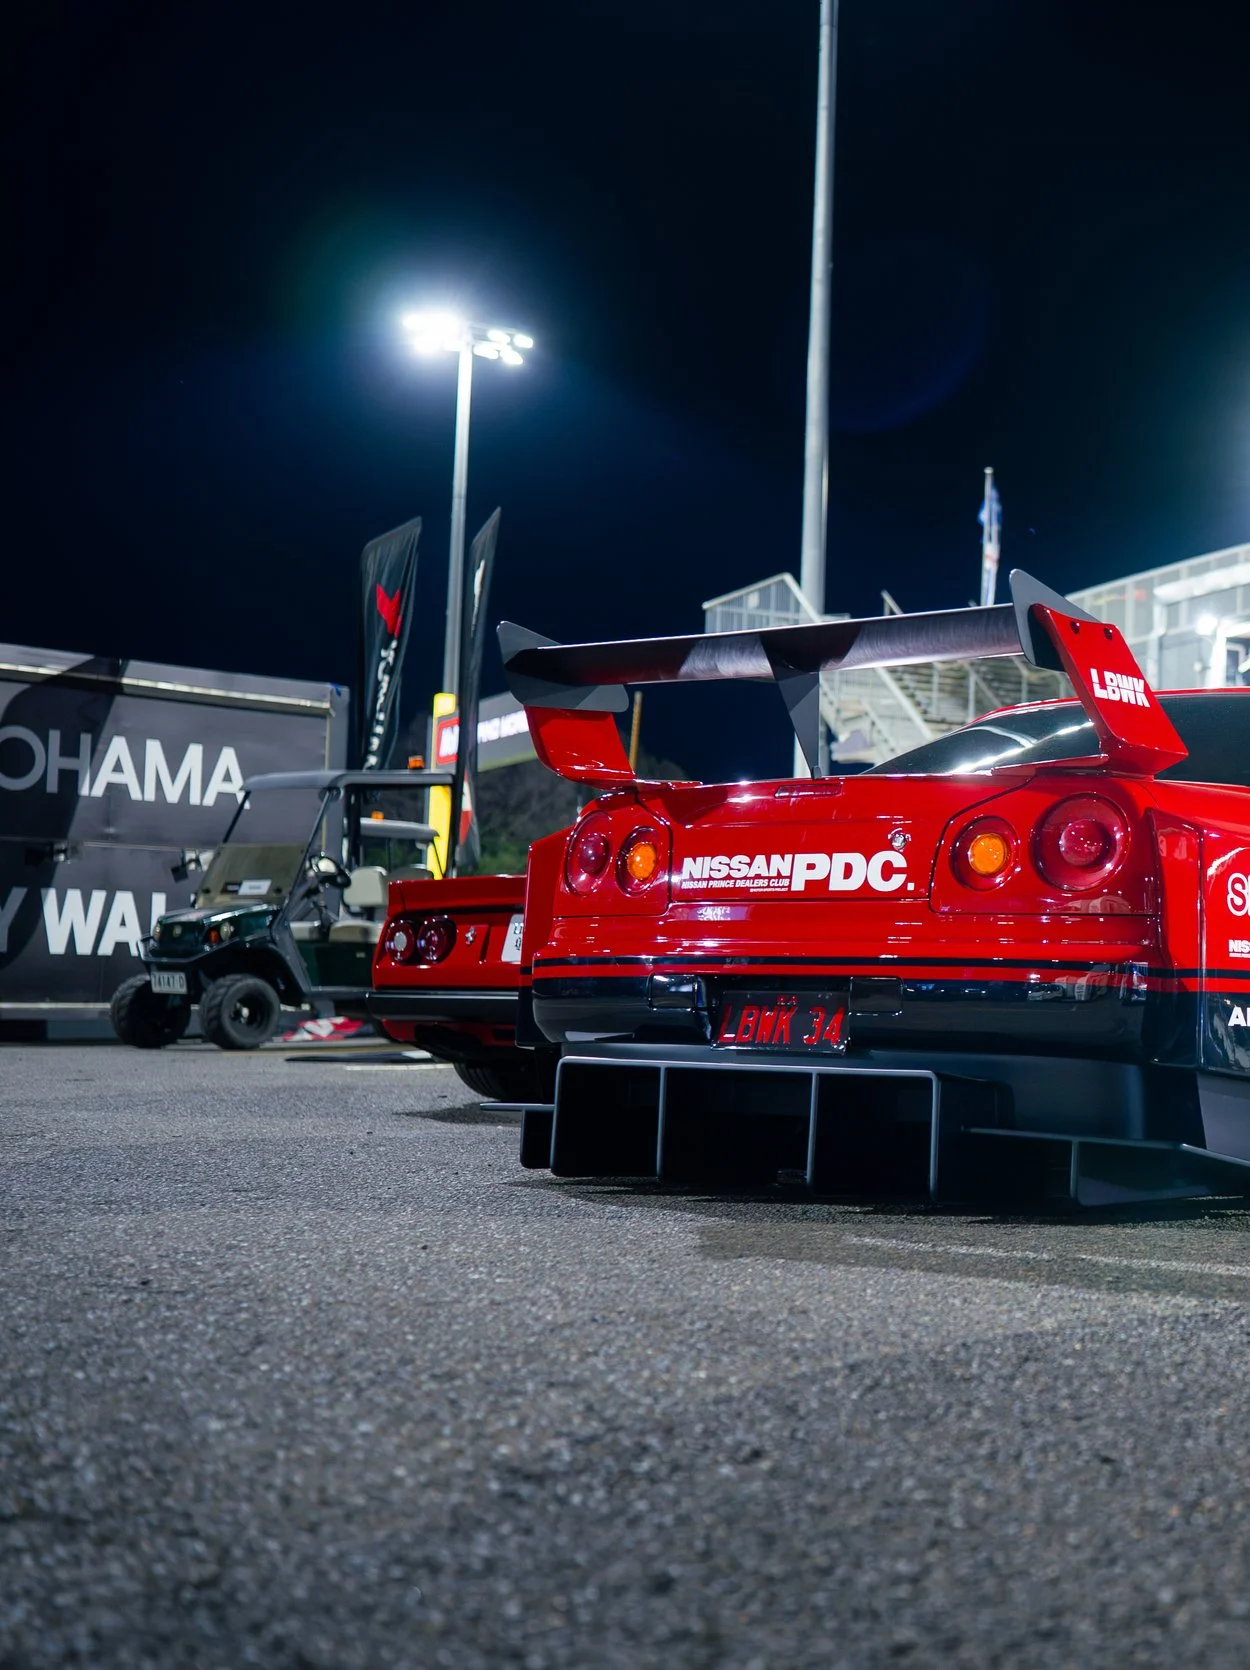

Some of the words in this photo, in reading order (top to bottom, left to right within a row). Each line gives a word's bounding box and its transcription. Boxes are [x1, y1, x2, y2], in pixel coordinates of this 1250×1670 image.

[1090, 668, 1151, 708] LBWK
[682, 854, 793, 879] NISSAN
[681, 880, 708, 889] NISSAN
[708, 880, 735, 888] PRINCE
[736, 879, 768, 887] DEALERS
[769, 878, 790, 887] CLUB
[718, 1003, 799, 1044] LBWK
[803, 1006, 845, 1046] 34
